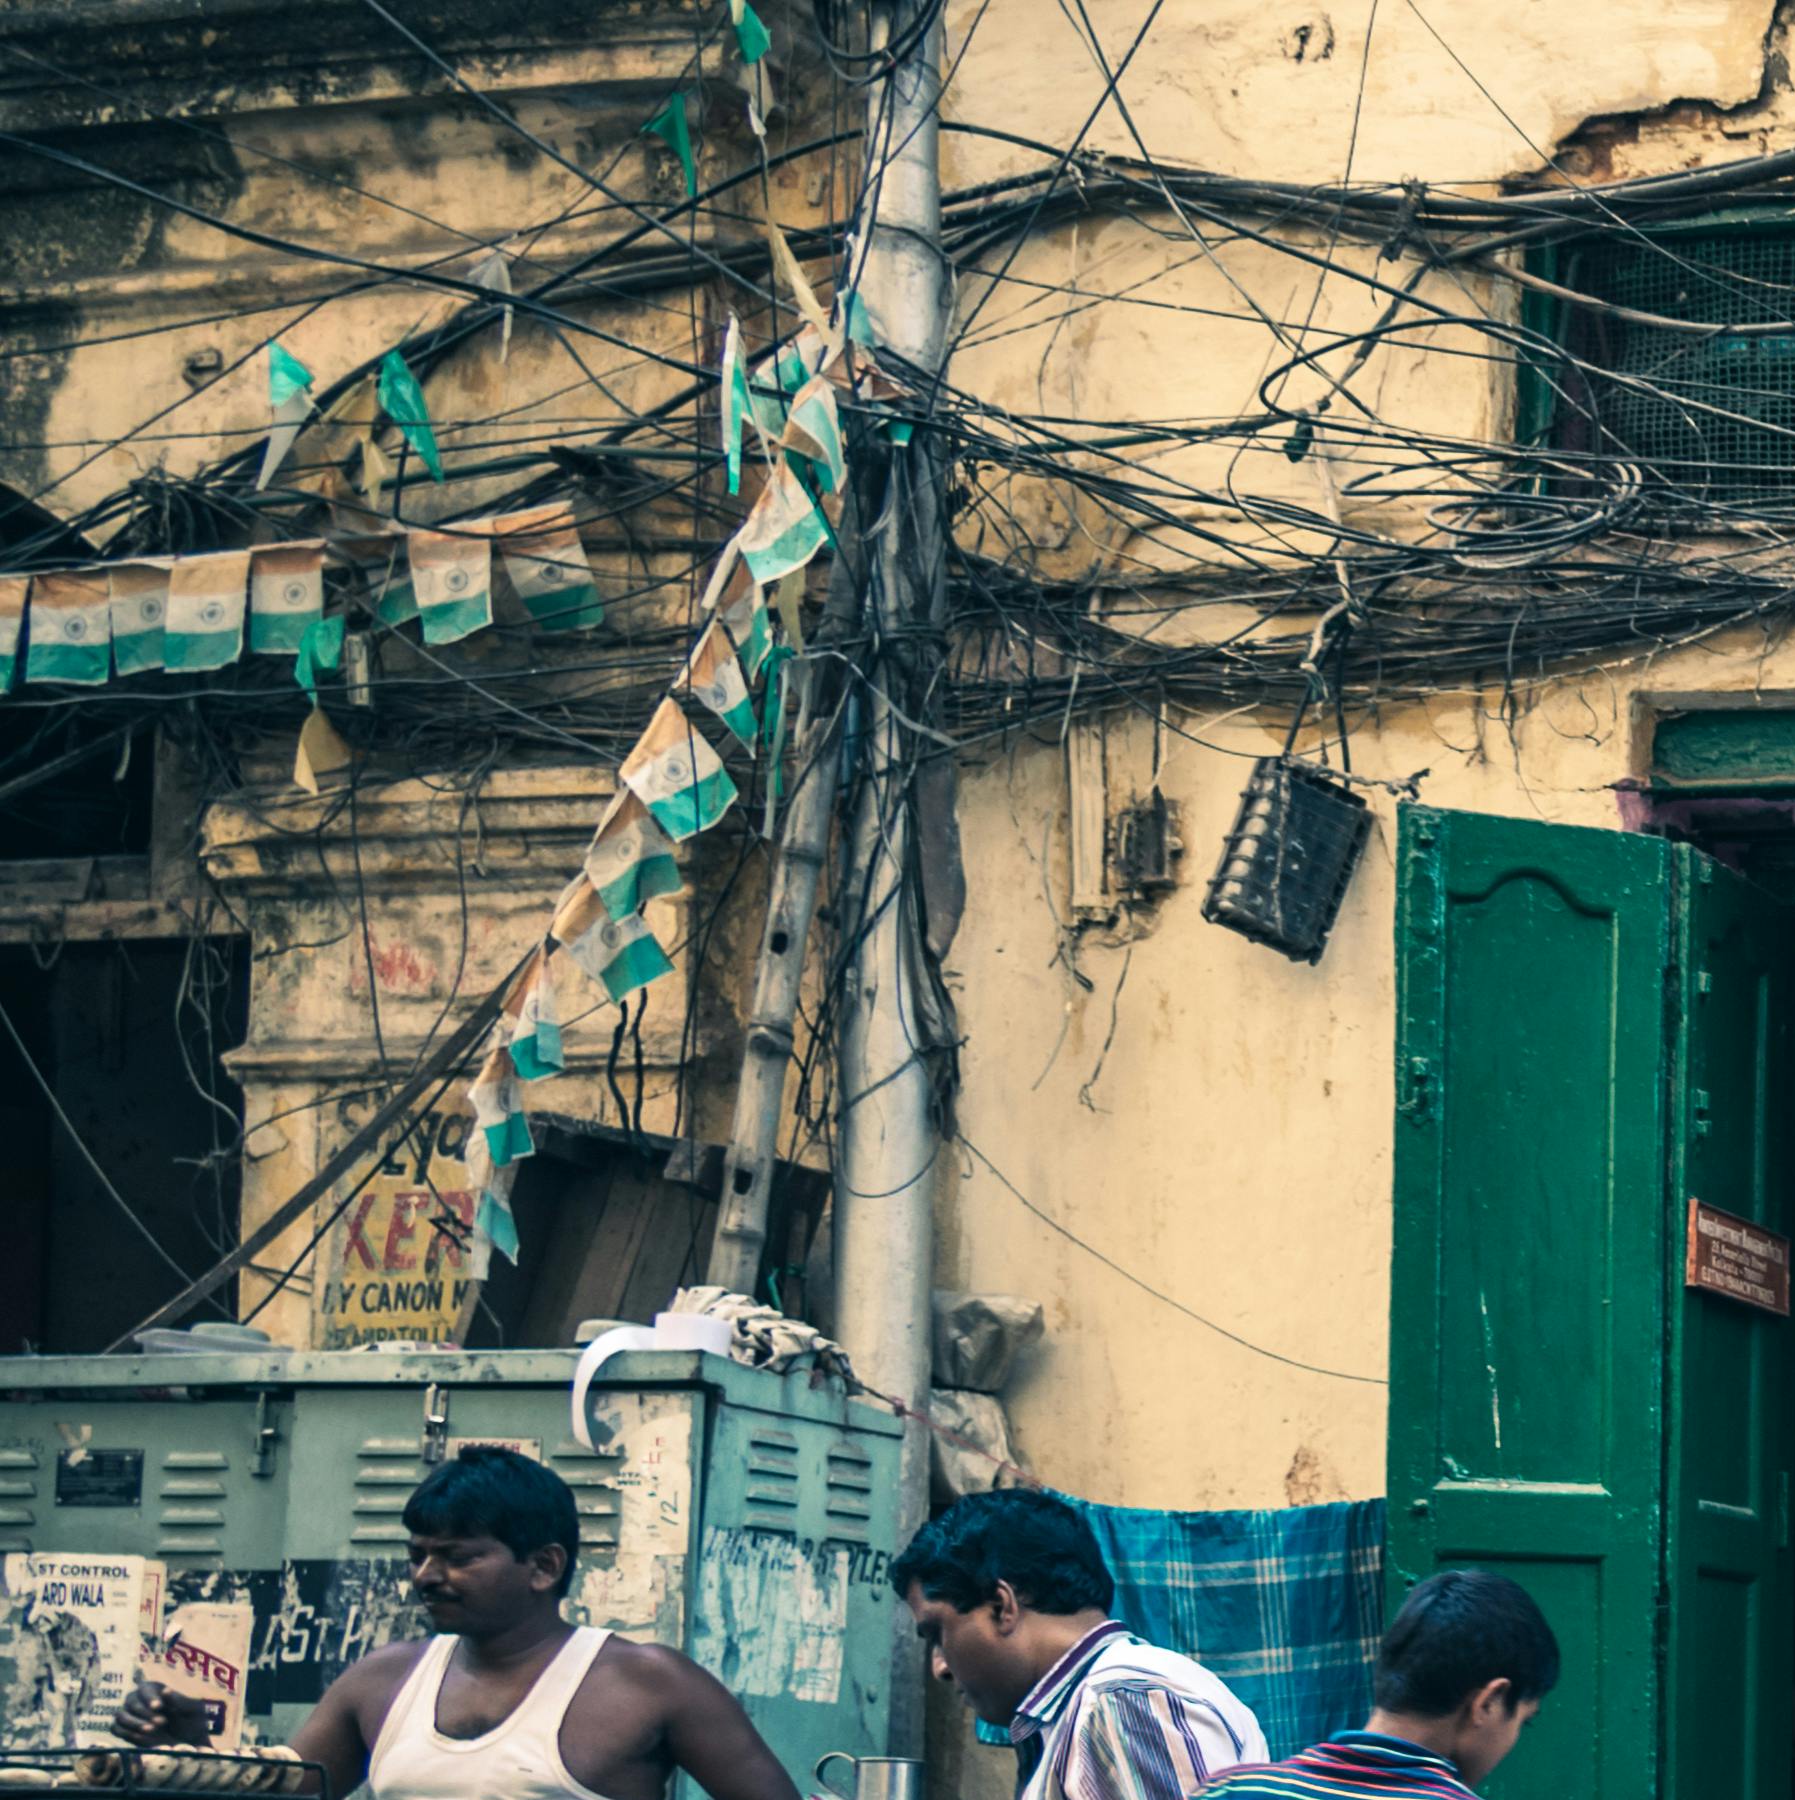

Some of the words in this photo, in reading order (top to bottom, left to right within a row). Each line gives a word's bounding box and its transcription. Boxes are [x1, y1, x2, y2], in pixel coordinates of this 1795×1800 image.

[360, 1280, 443, 1313] CANON
[60, 1564, 130, 1578] CONTROL
[71, 1582, 105, 1607] WALA
